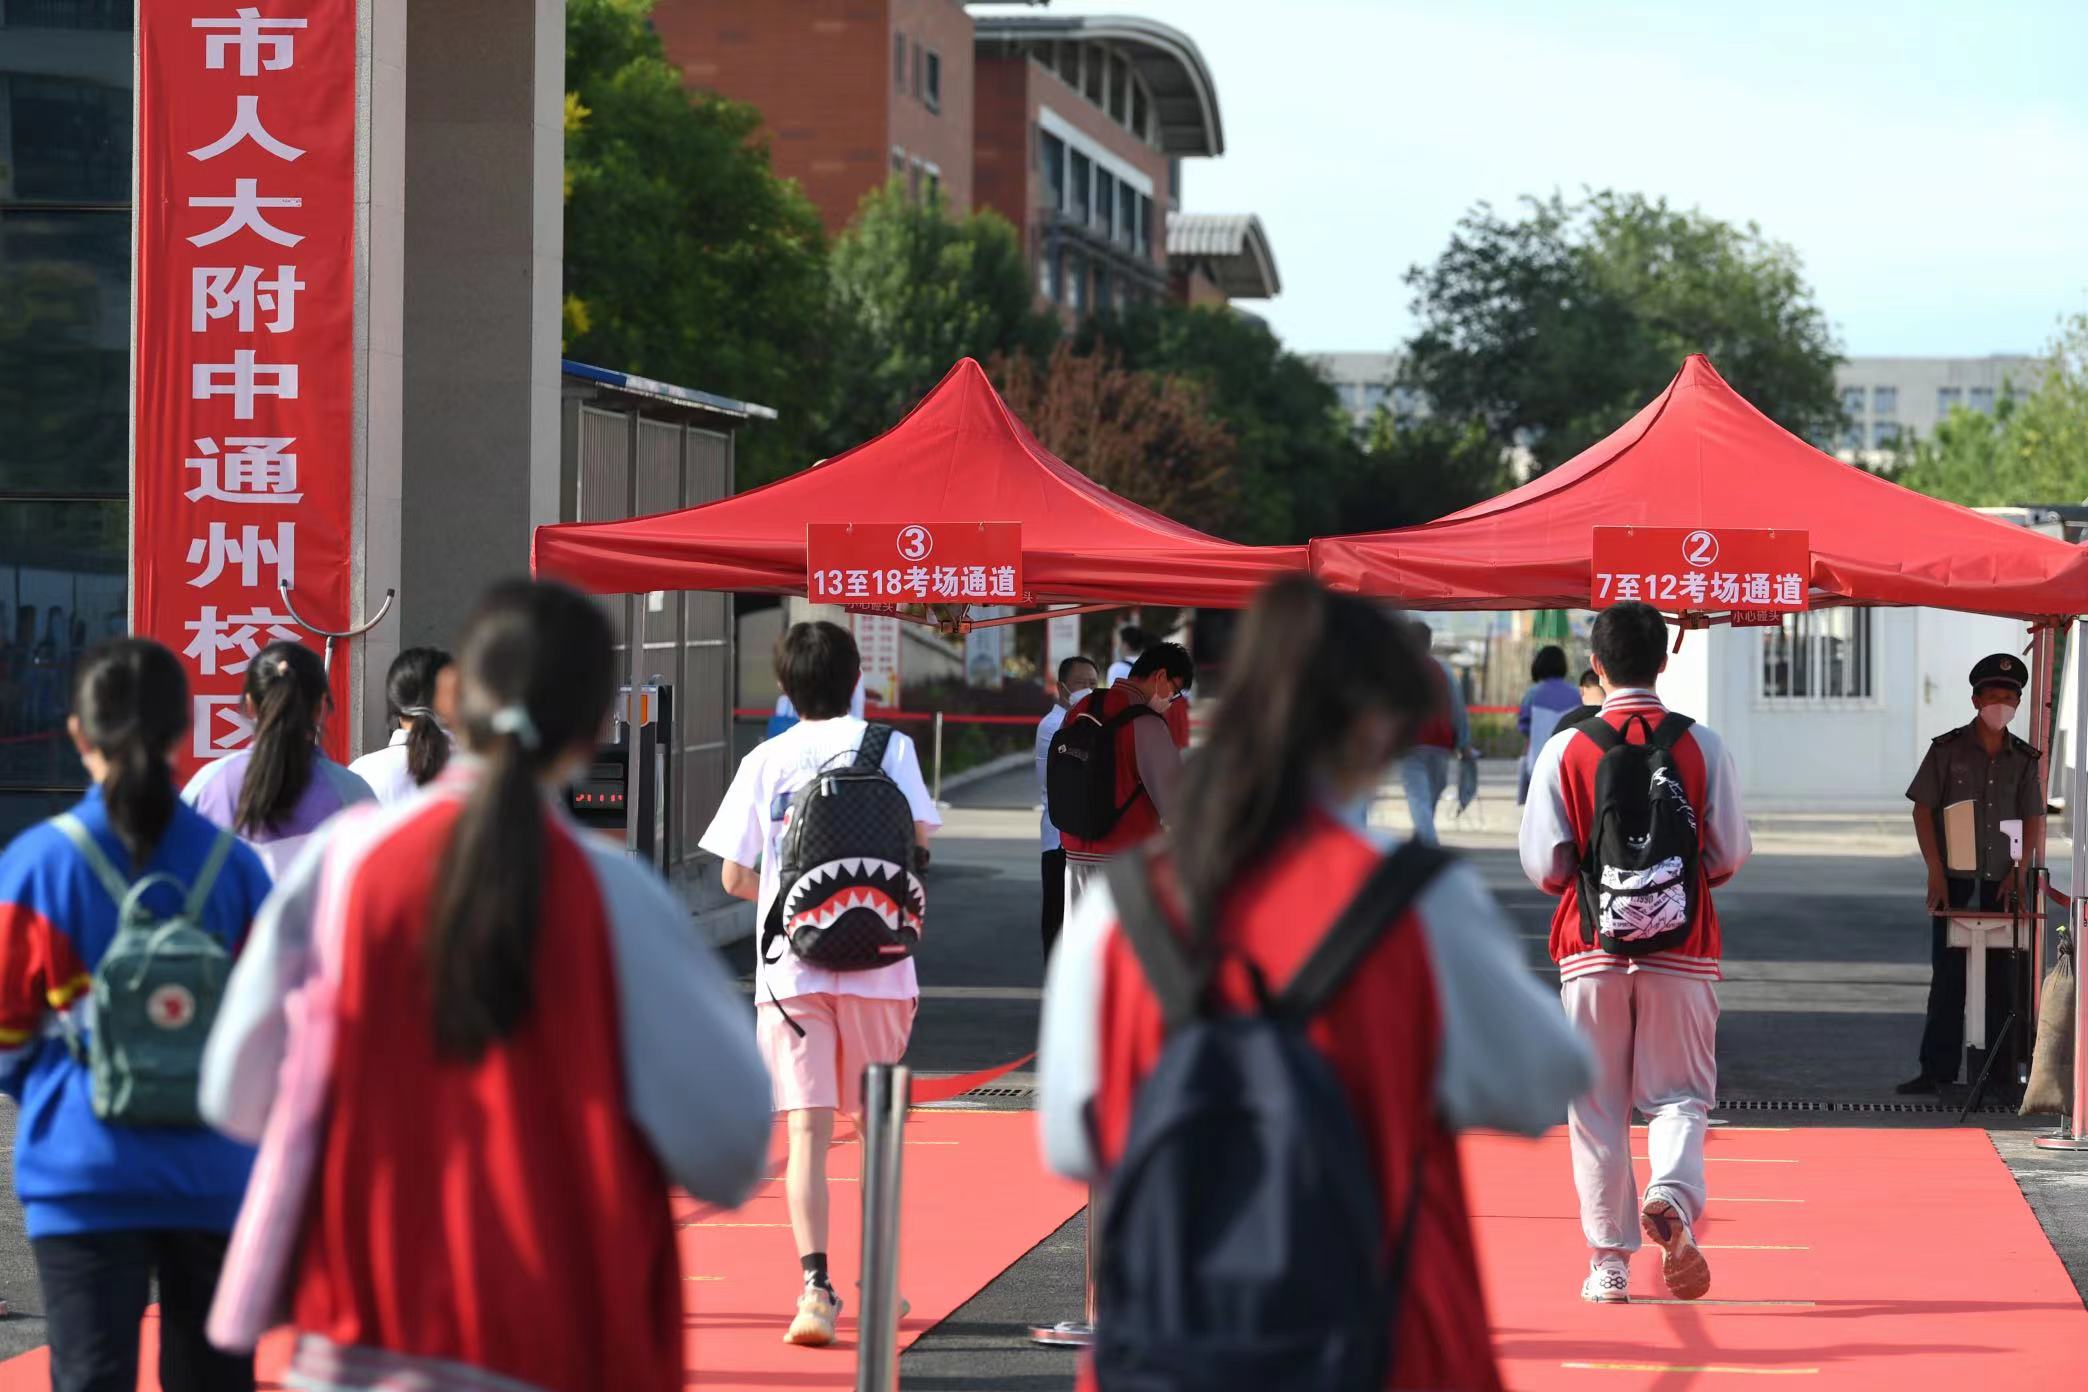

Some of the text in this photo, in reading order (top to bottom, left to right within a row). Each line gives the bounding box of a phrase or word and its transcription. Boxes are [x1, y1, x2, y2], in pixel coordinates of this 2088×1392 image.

[813, 565, 1017, 597] 13至18考场通道
[1596, 571, 1803, 604] 7至12考场通道
